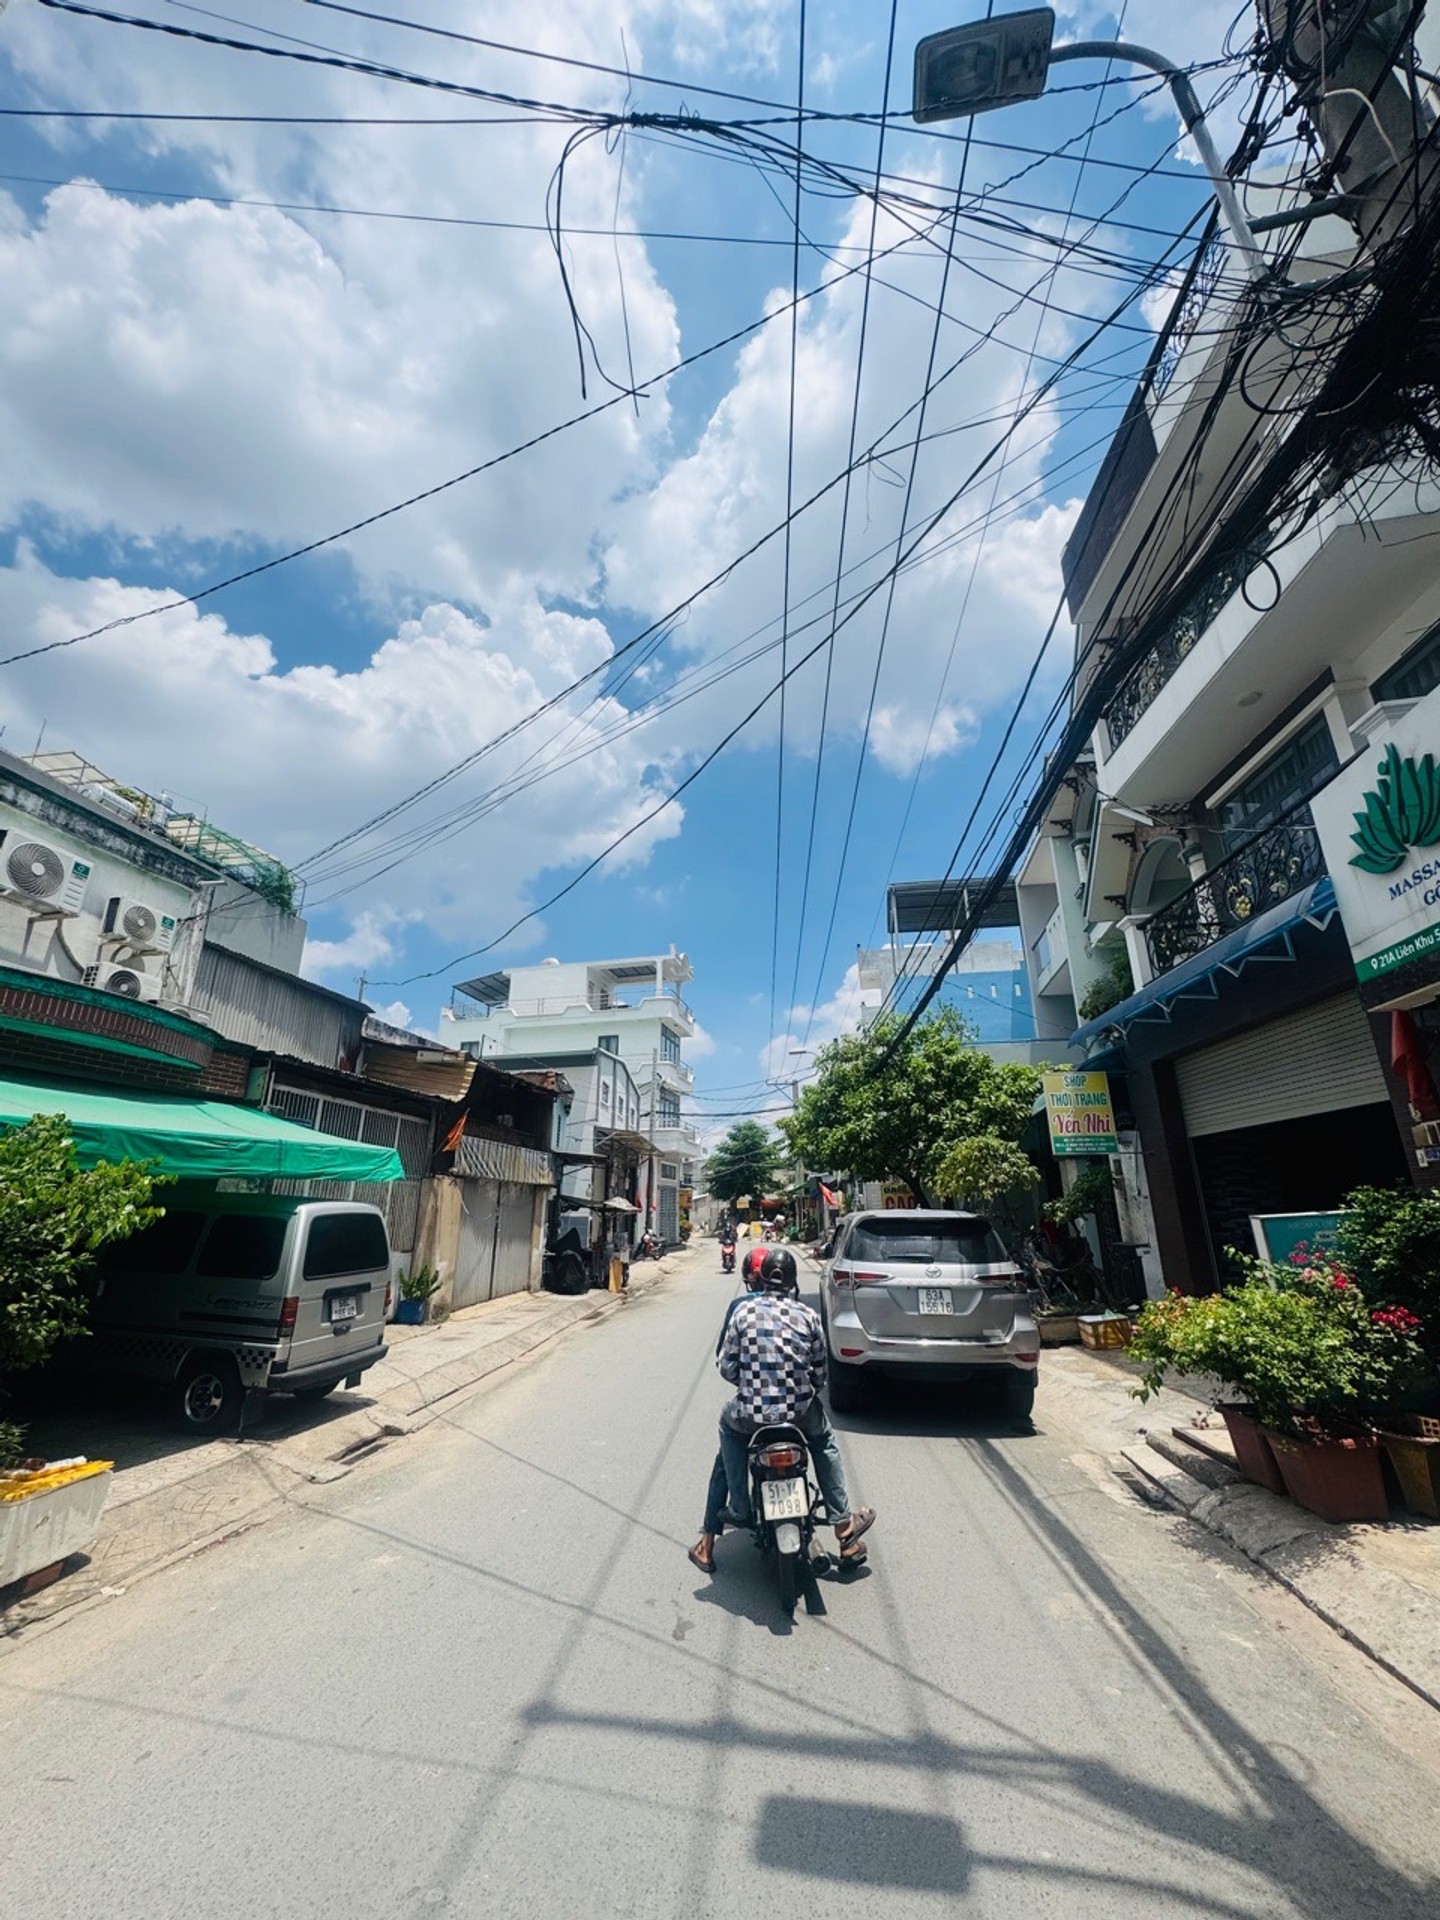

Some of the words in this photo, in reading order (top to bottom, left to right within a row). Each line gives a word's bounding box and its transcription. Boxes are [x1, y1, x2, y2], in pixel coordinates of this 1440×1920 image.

[1379, 952, 1396, 967] 21A
[1395, 944, 1415, 960] Liên
[1415, 935, 1434, 950] Khu
[1064, 1075, 1087, 1087] SHOP
[1075, 1092, 1108, 1106] TRANG
[1053, 1110, 1081, 1133] Yến
[1083, 1113, 1111, 1133] Nhi
[769, 1498, 801, 1516] 7098
